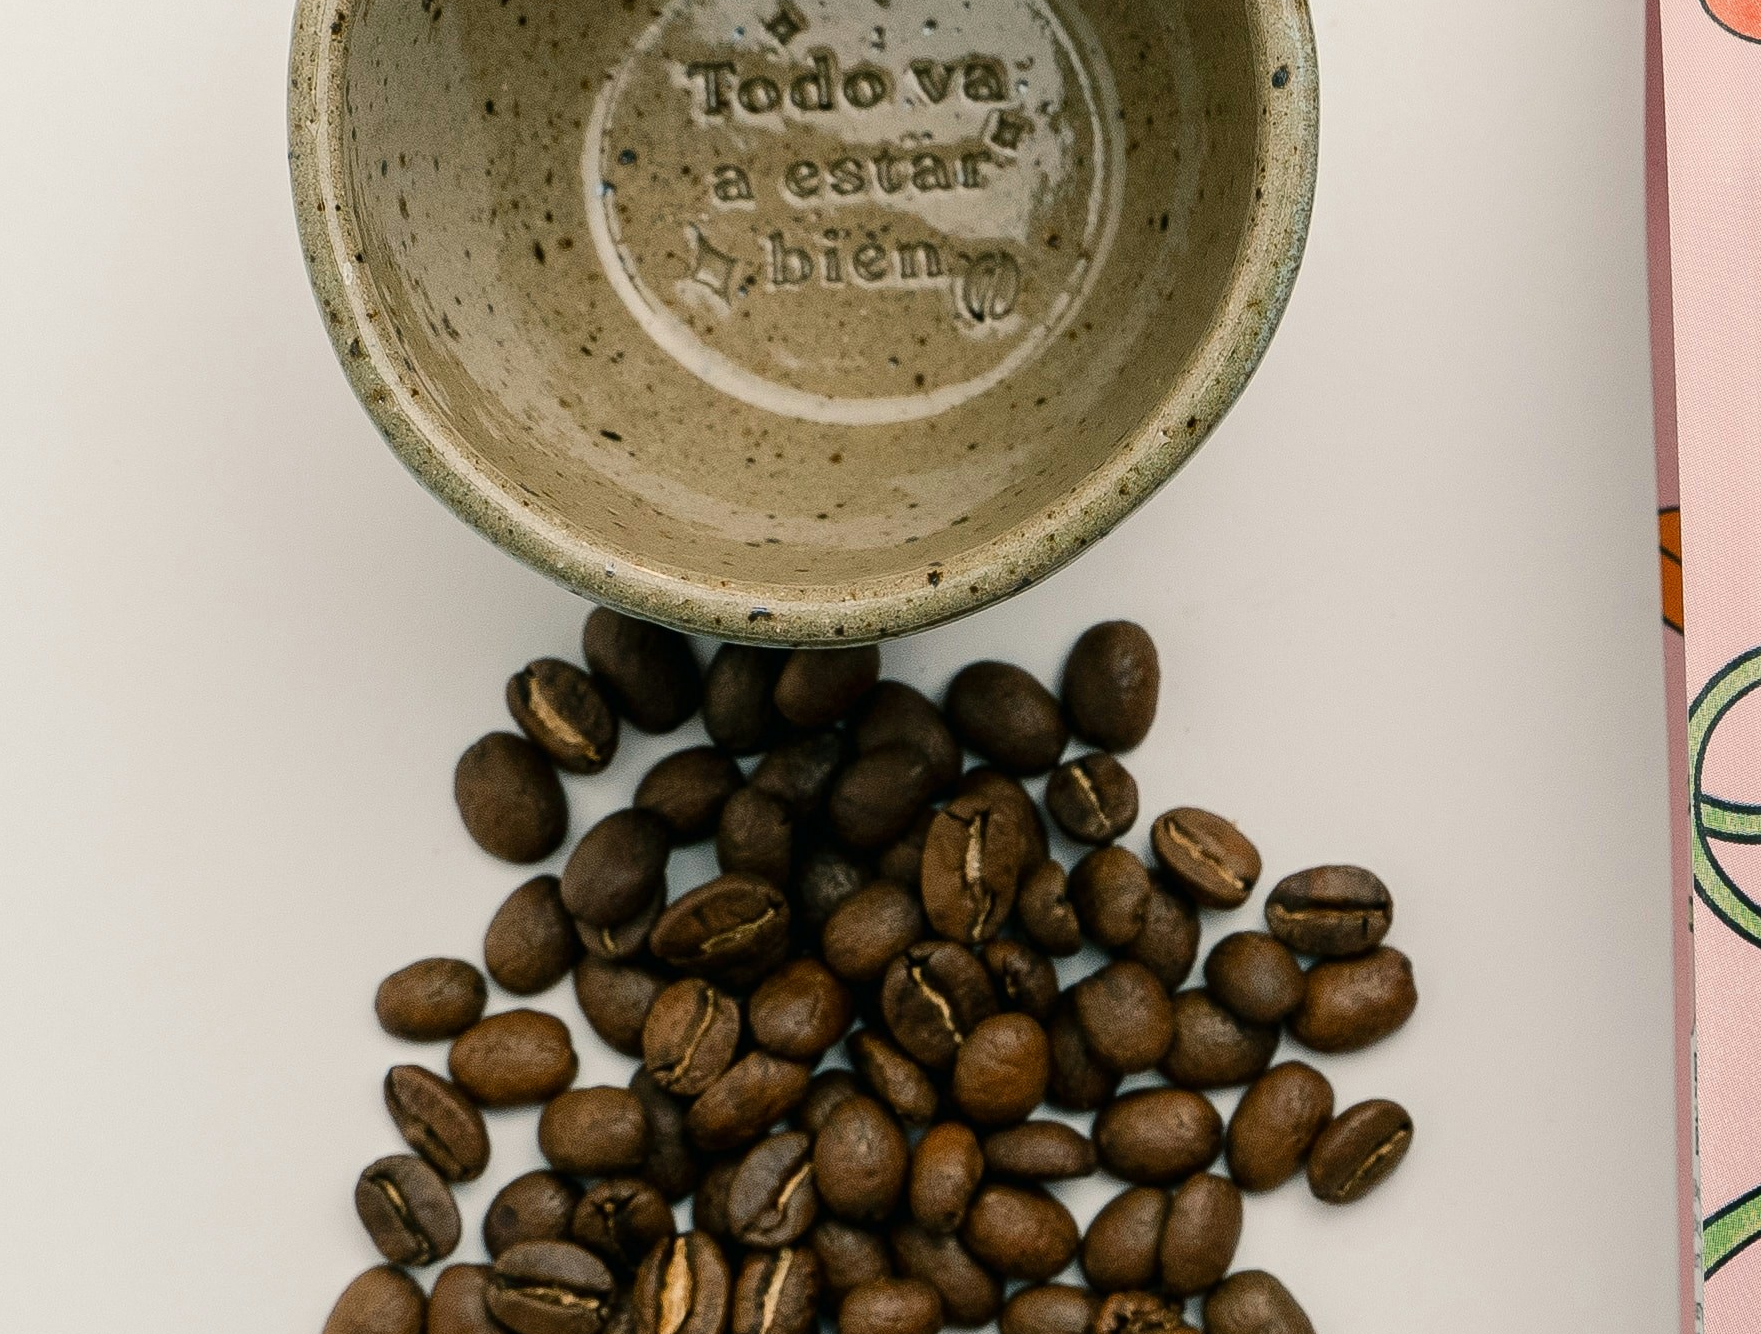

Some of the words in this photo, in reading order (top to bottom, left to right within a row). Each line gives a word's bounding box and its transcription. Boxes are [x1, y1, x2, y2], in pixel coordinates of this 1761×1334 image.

[685, 52, 887, 117] Todo
[911, 58, 1007, 105] va
[711, 165, 755, 203] a
[782, 146, 995, 197] estar
[766, 229, 943, 287] bien
